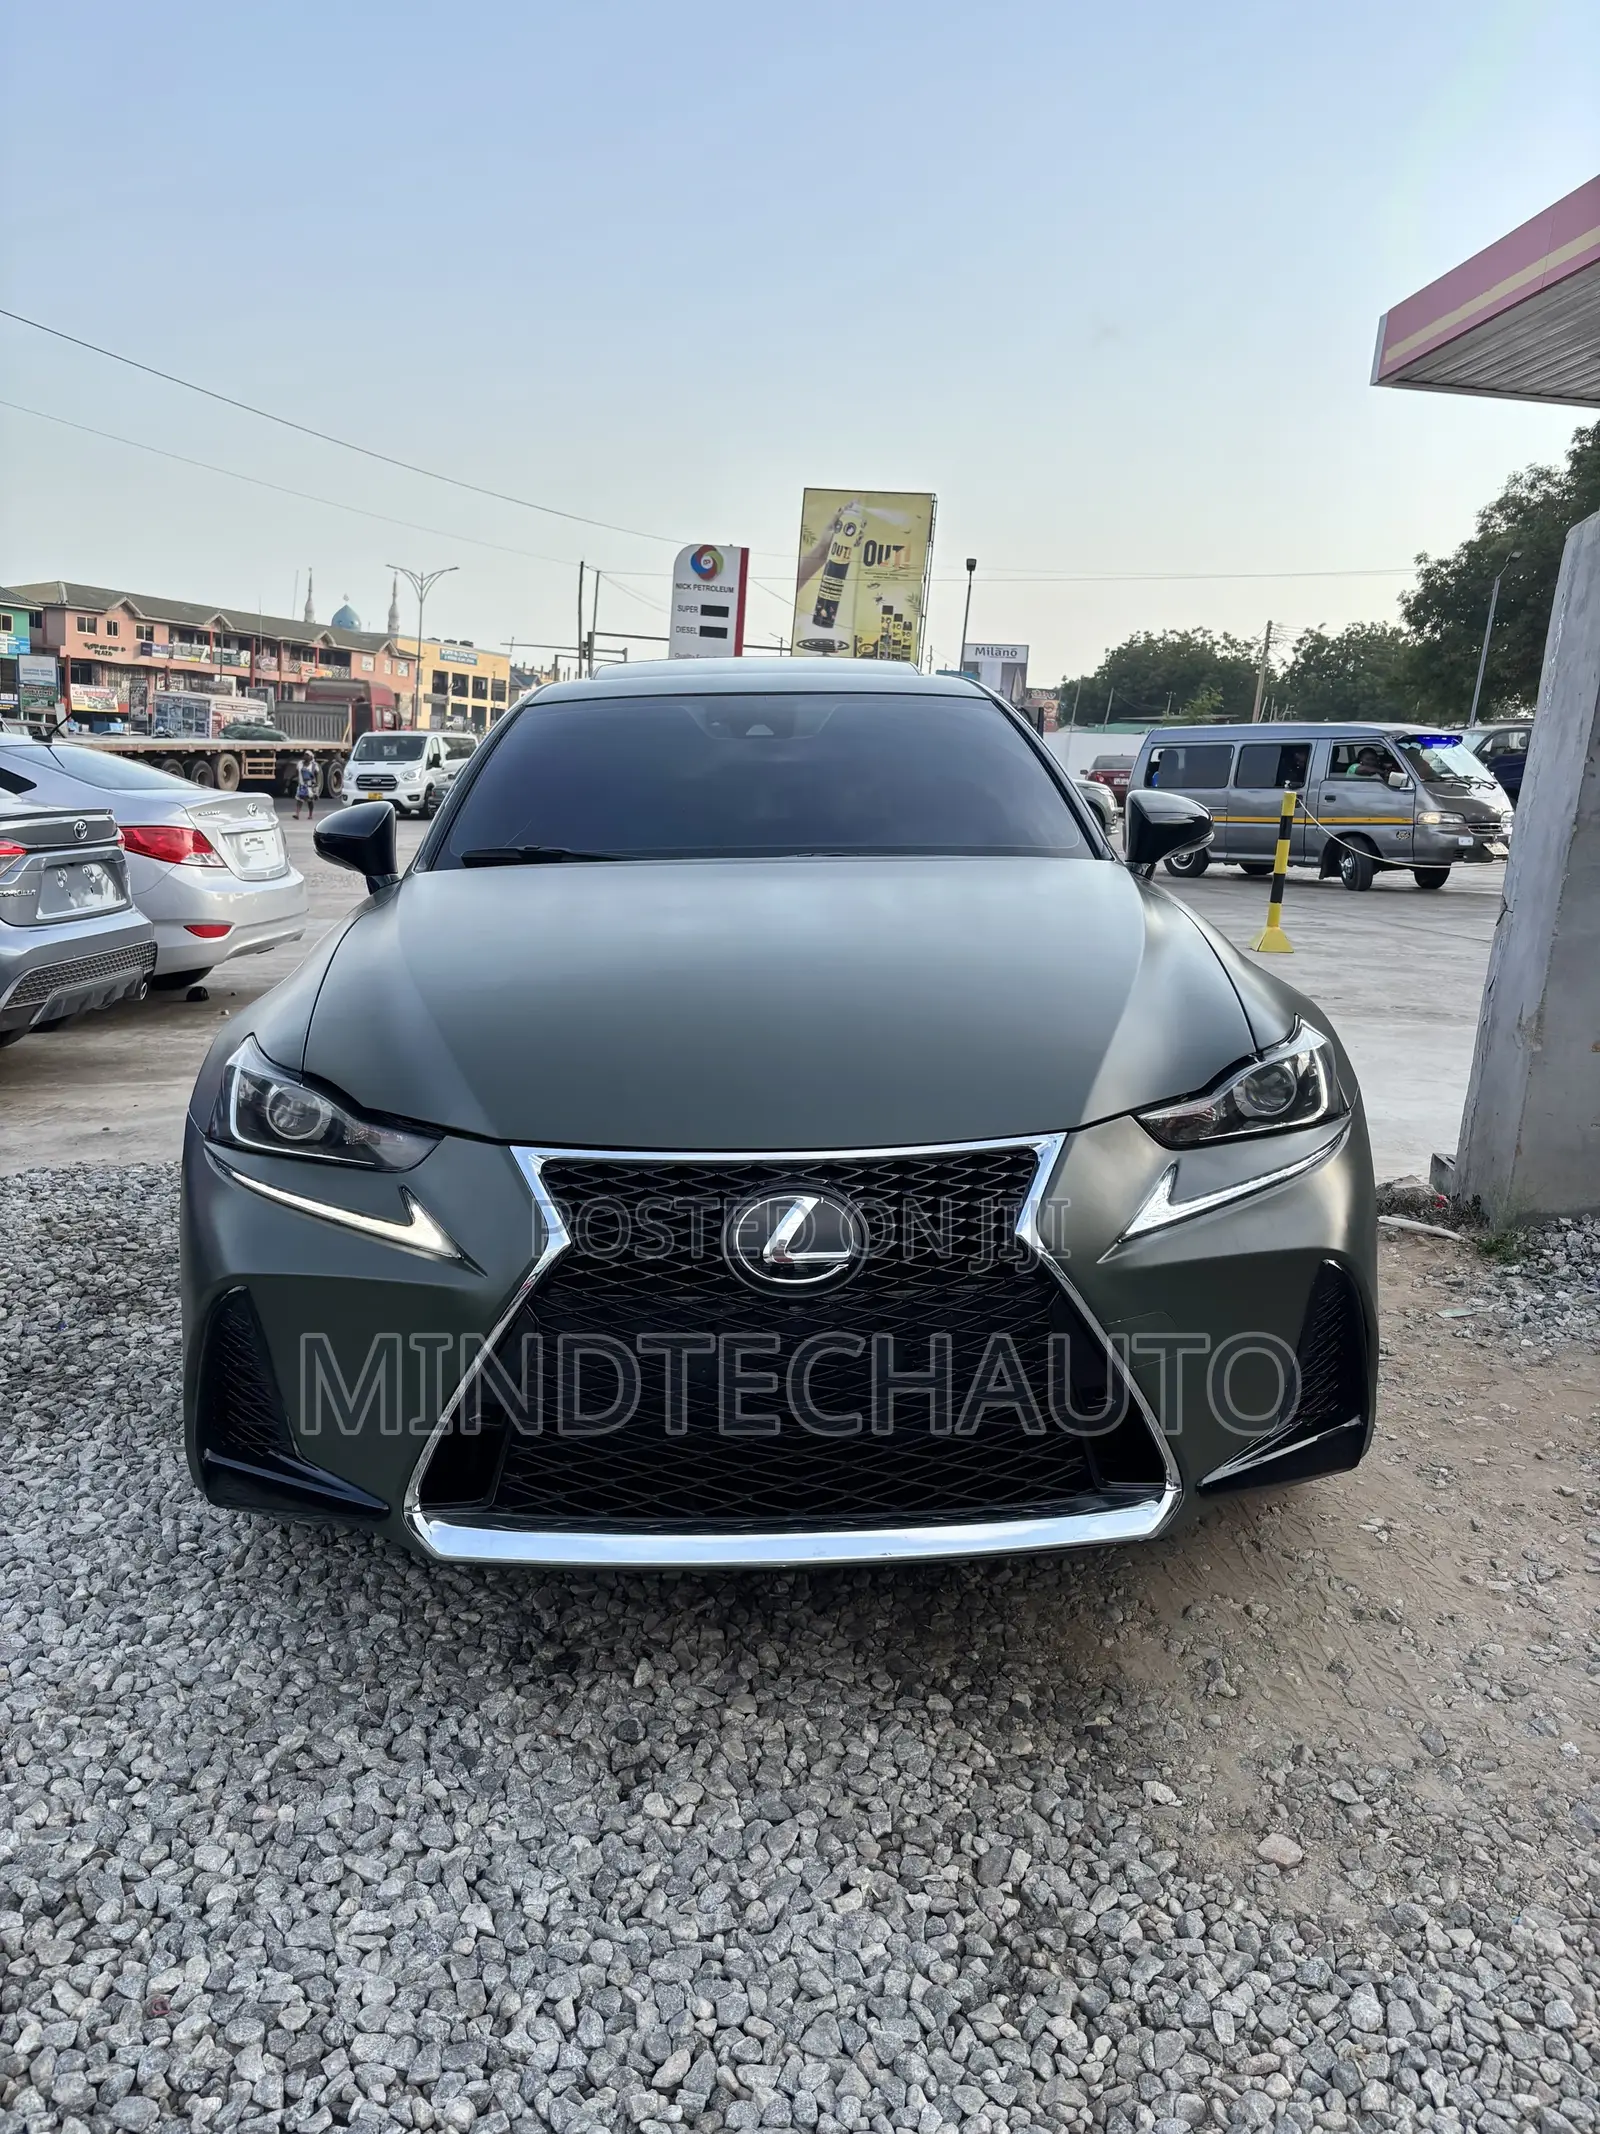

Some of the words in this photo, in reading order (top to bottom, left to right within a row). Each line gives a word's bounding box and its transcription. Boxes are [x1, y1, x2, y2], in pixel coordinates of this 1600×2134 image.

[863, 540, 912, 569] OUT!
[675, 583, 692, 591] NICK
[693, 583, 735, 594] PETROLEUM
[677, 604, 699, 613] SUPER
[675, 626, 698, 635] DIESEL
